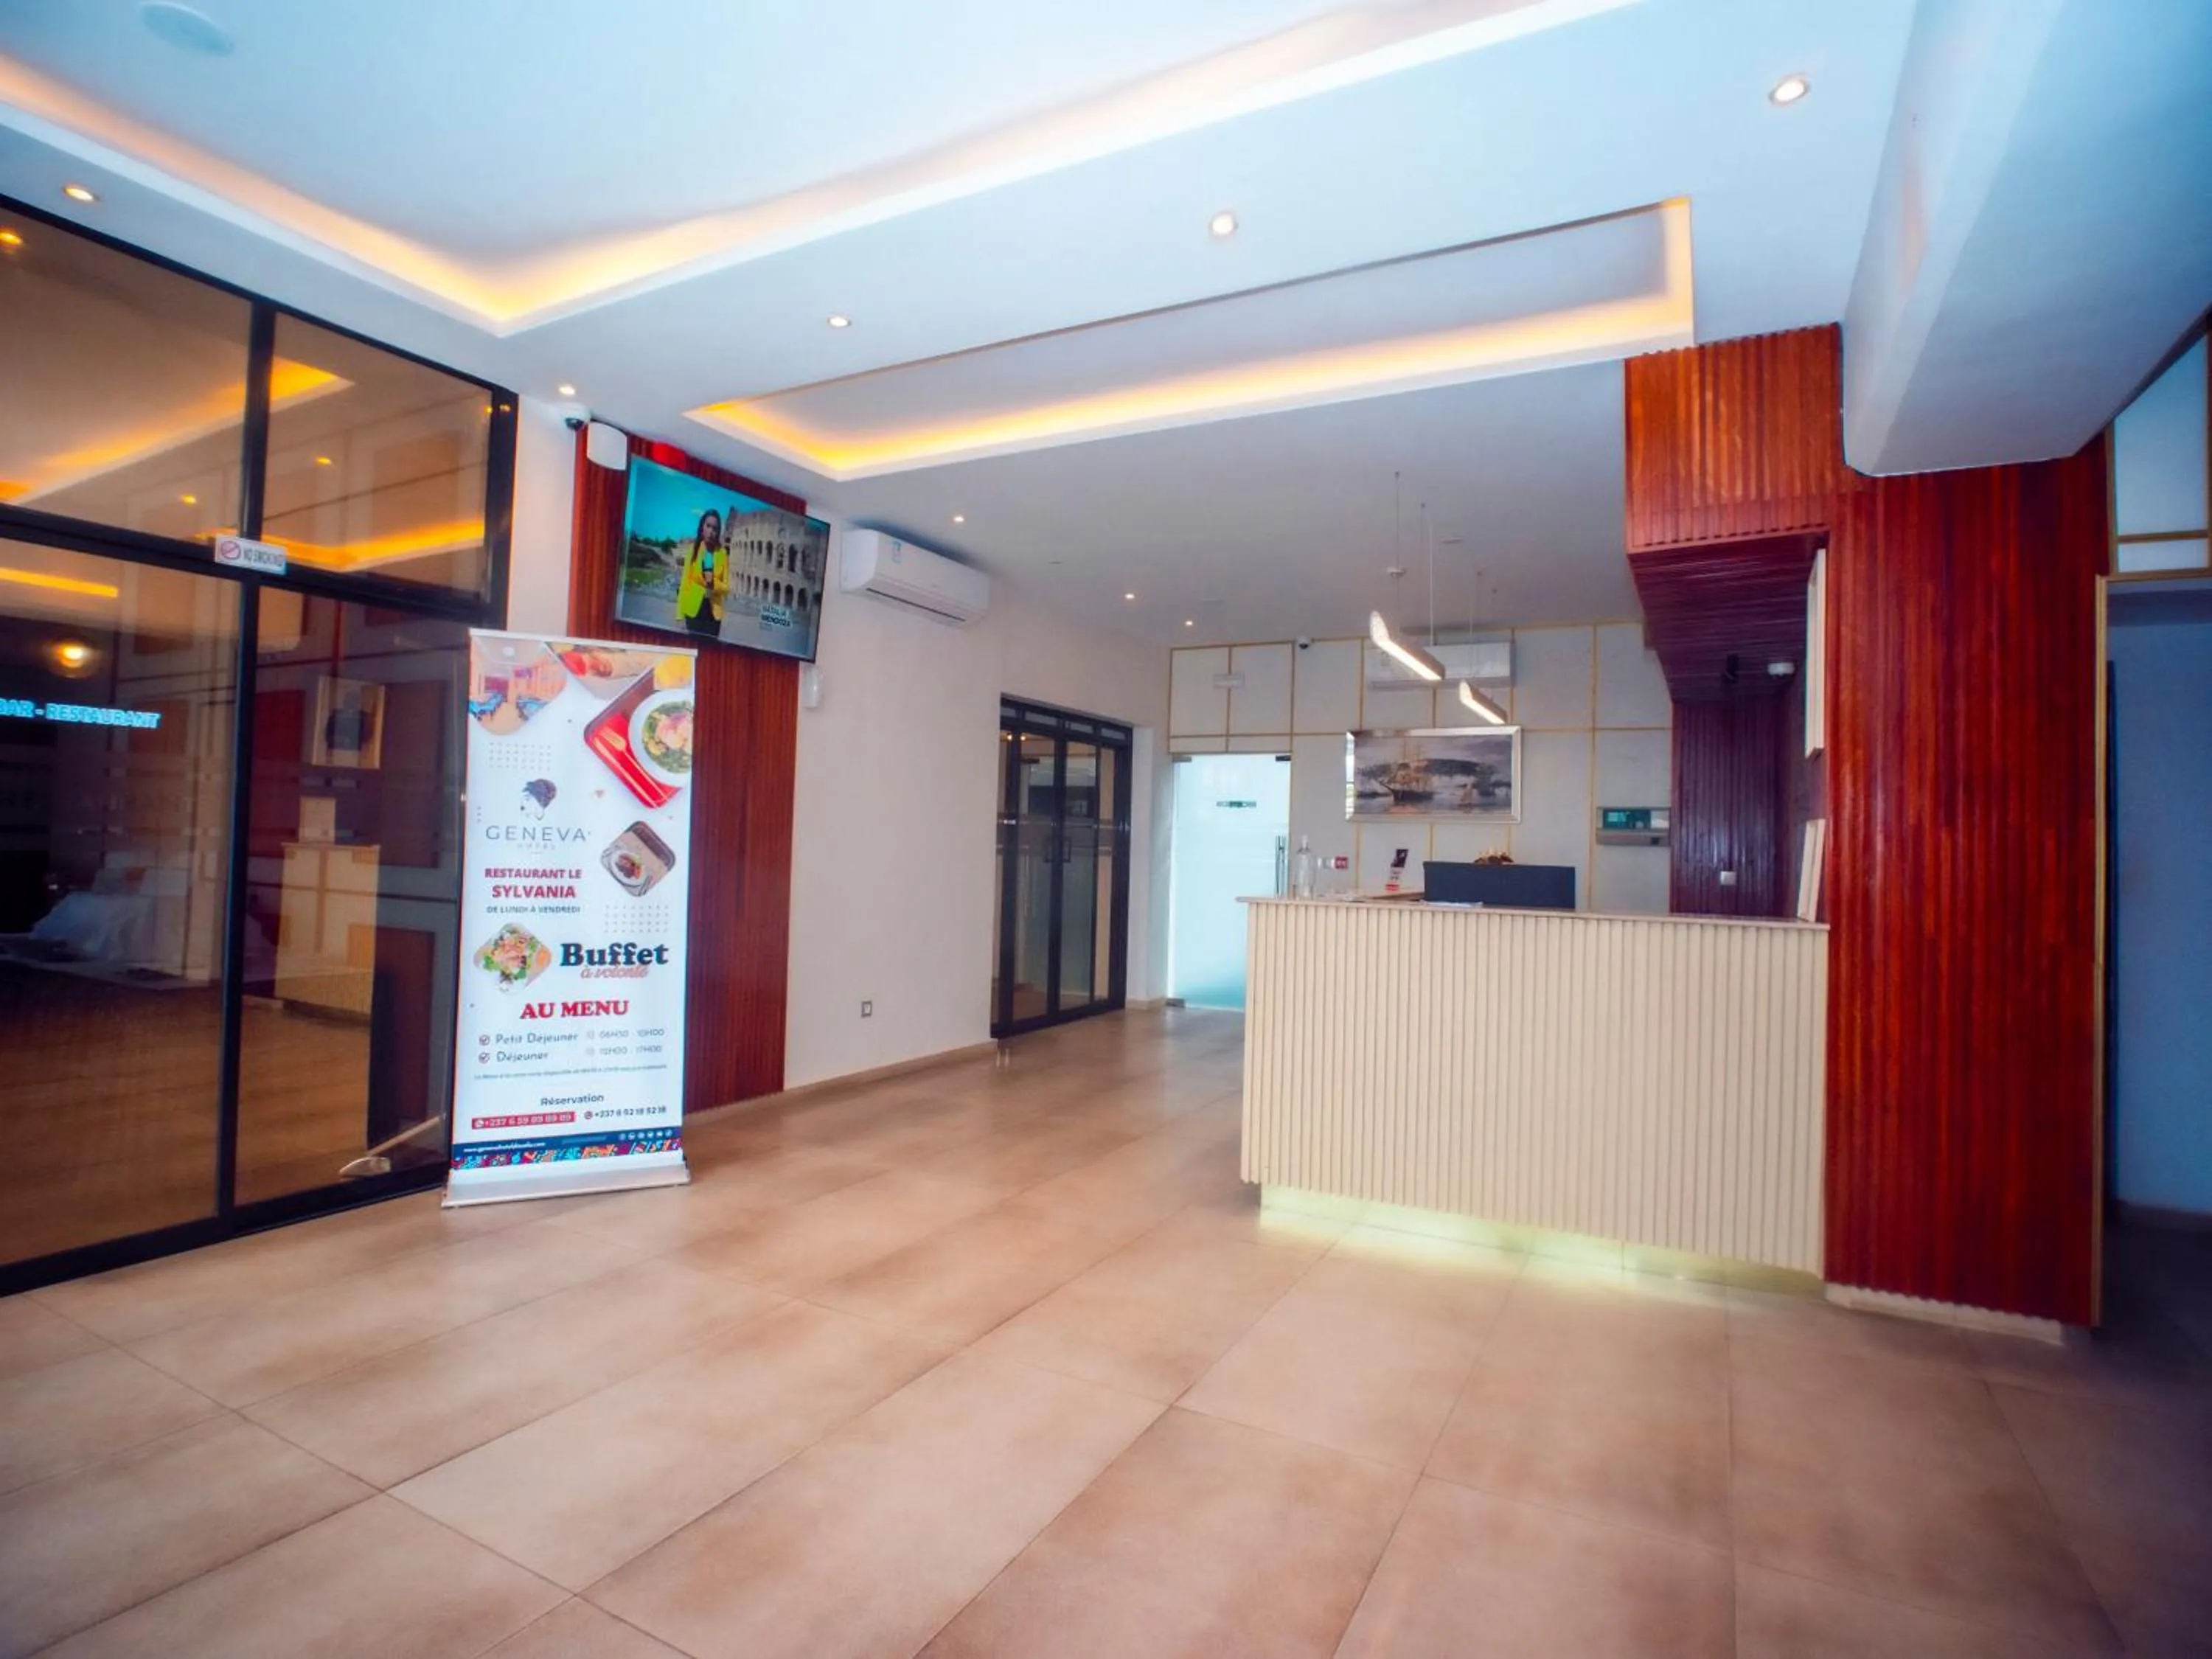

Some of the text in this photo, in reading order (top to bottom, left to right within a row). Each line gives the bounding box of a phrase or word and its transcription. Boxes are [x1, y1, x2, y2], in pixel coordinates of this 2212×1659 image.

[46, 703, 160, 728] RESTAURANT
[486, 825, 587, 841] GENEVA
[484, 868, 582, 879] RESTAURANT LE
[492, 885, 576, 898] SYLVANIA
[560, 942, 669, 966] Buffet
[519, 1000, 629, 1020] AU MENU
[496, 1034, 522, 1044] Petit
